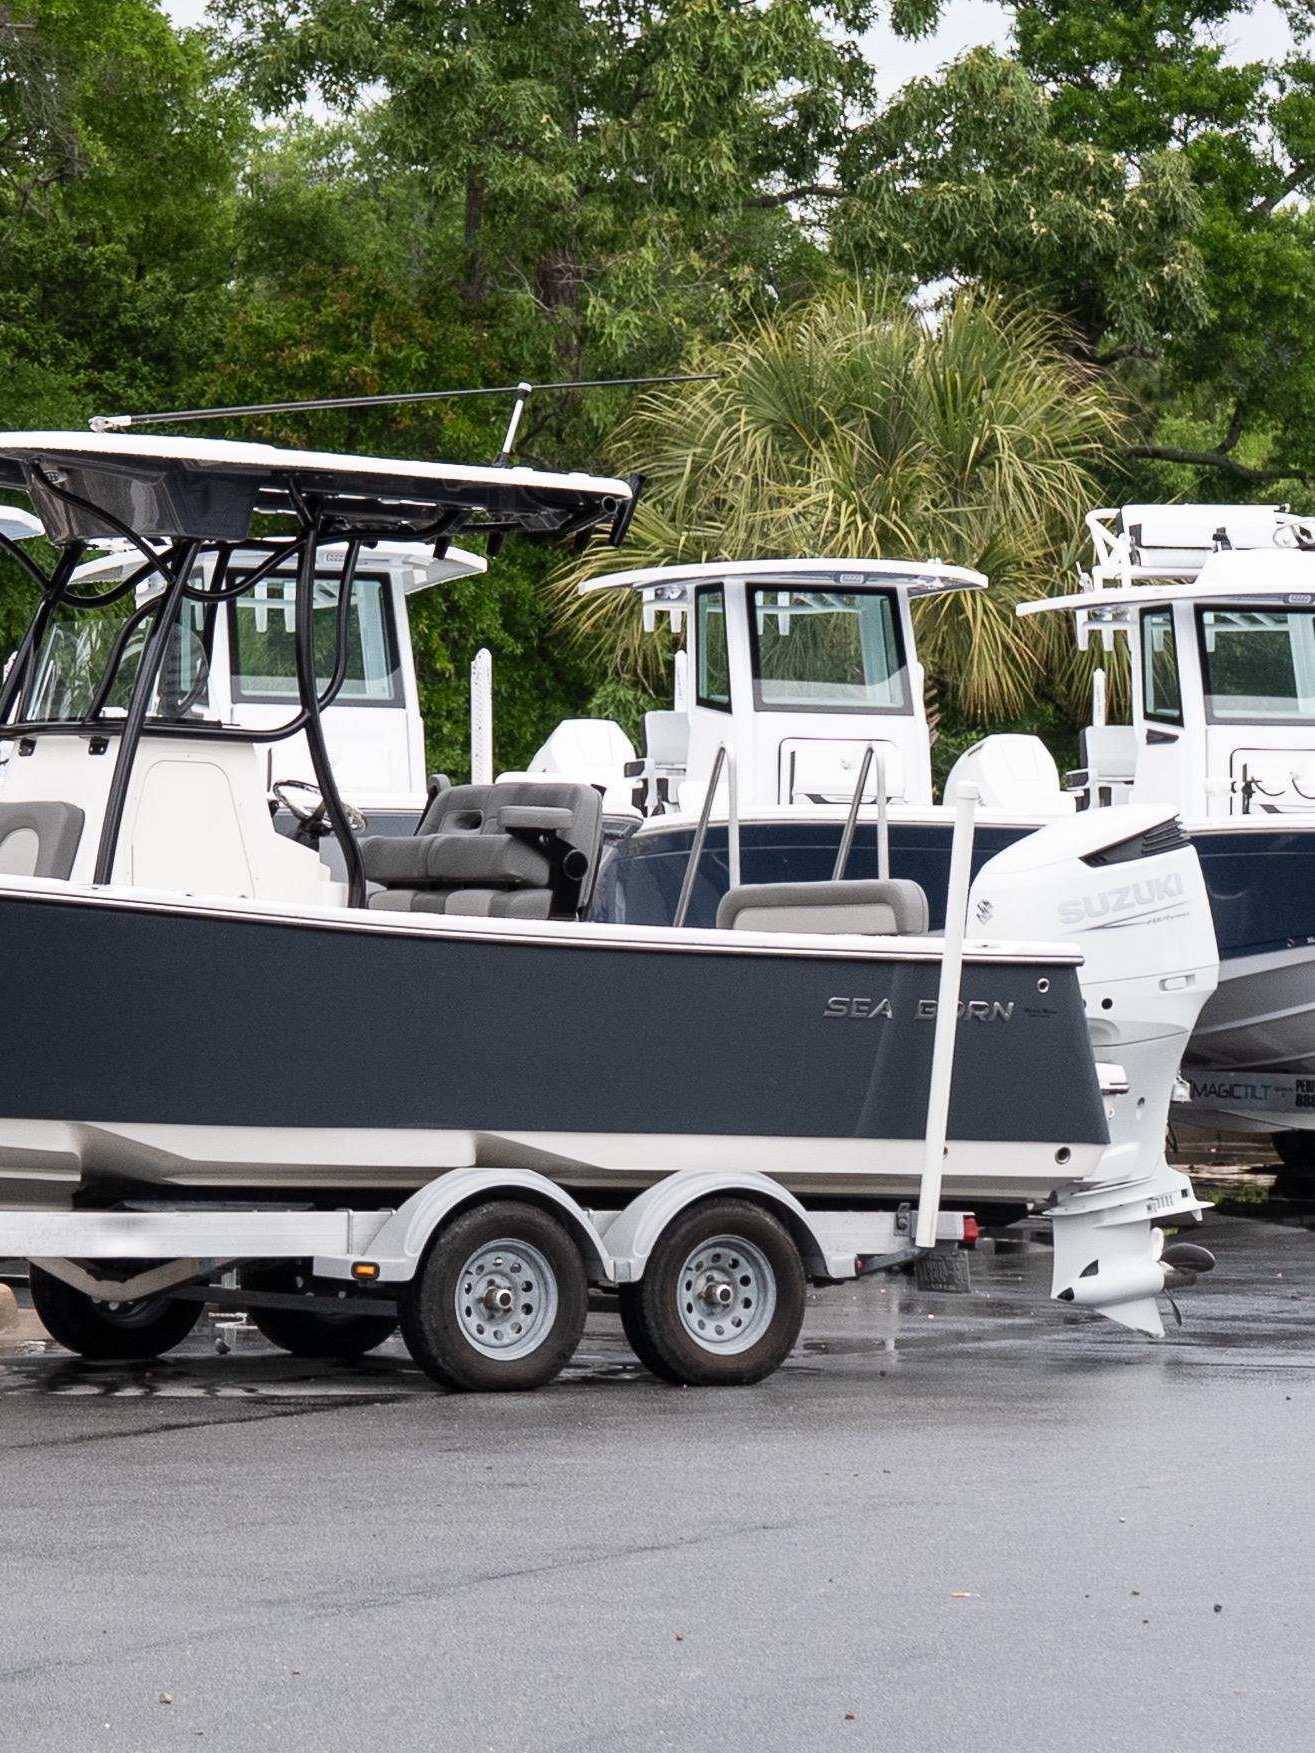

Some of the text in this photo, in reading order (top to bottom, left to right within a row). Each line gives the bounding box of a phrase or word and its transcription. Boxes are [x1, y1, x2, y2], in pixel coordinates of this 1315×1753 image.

[1057, 872, 1184, 925] SUZUKI
[823, 996, 893, 1020] SEA
[914, 999, 1016, 1022] BRN
